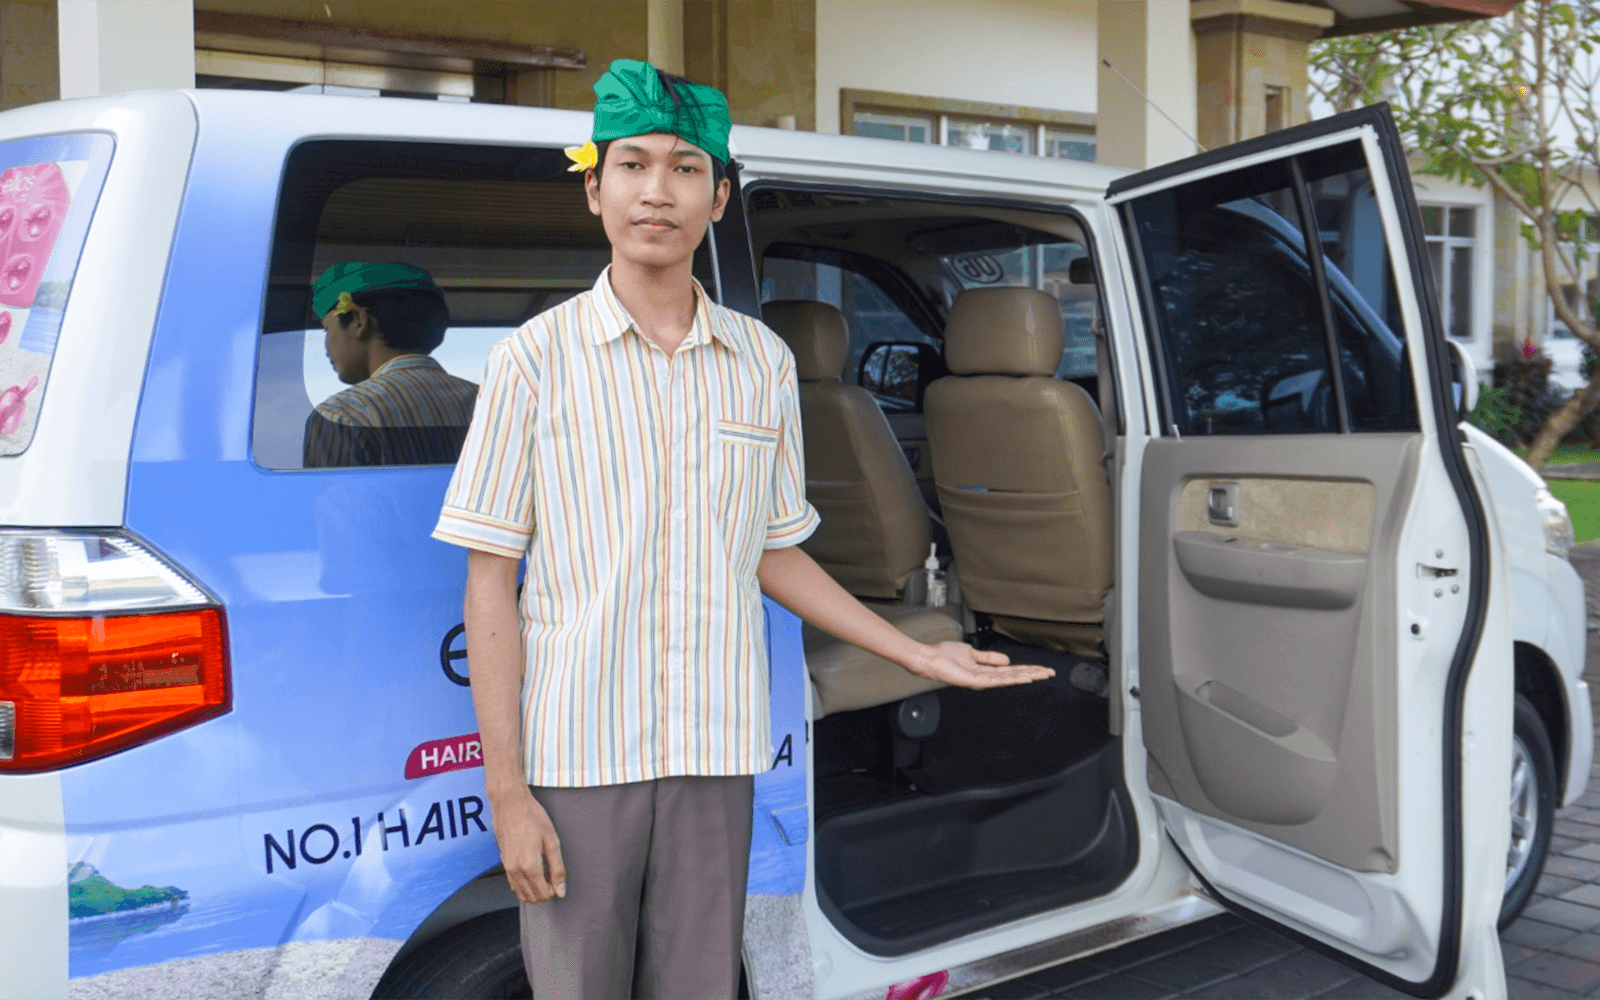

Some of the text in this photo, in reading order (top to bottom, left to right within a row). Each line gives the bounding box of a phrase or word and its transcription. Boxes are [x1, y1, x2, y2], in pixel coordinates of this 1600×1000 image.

[420, 740, 481, 770] HAIR
[263, 816, 362, 875] NO.1
[377, 795, 488, 852] HAIR
